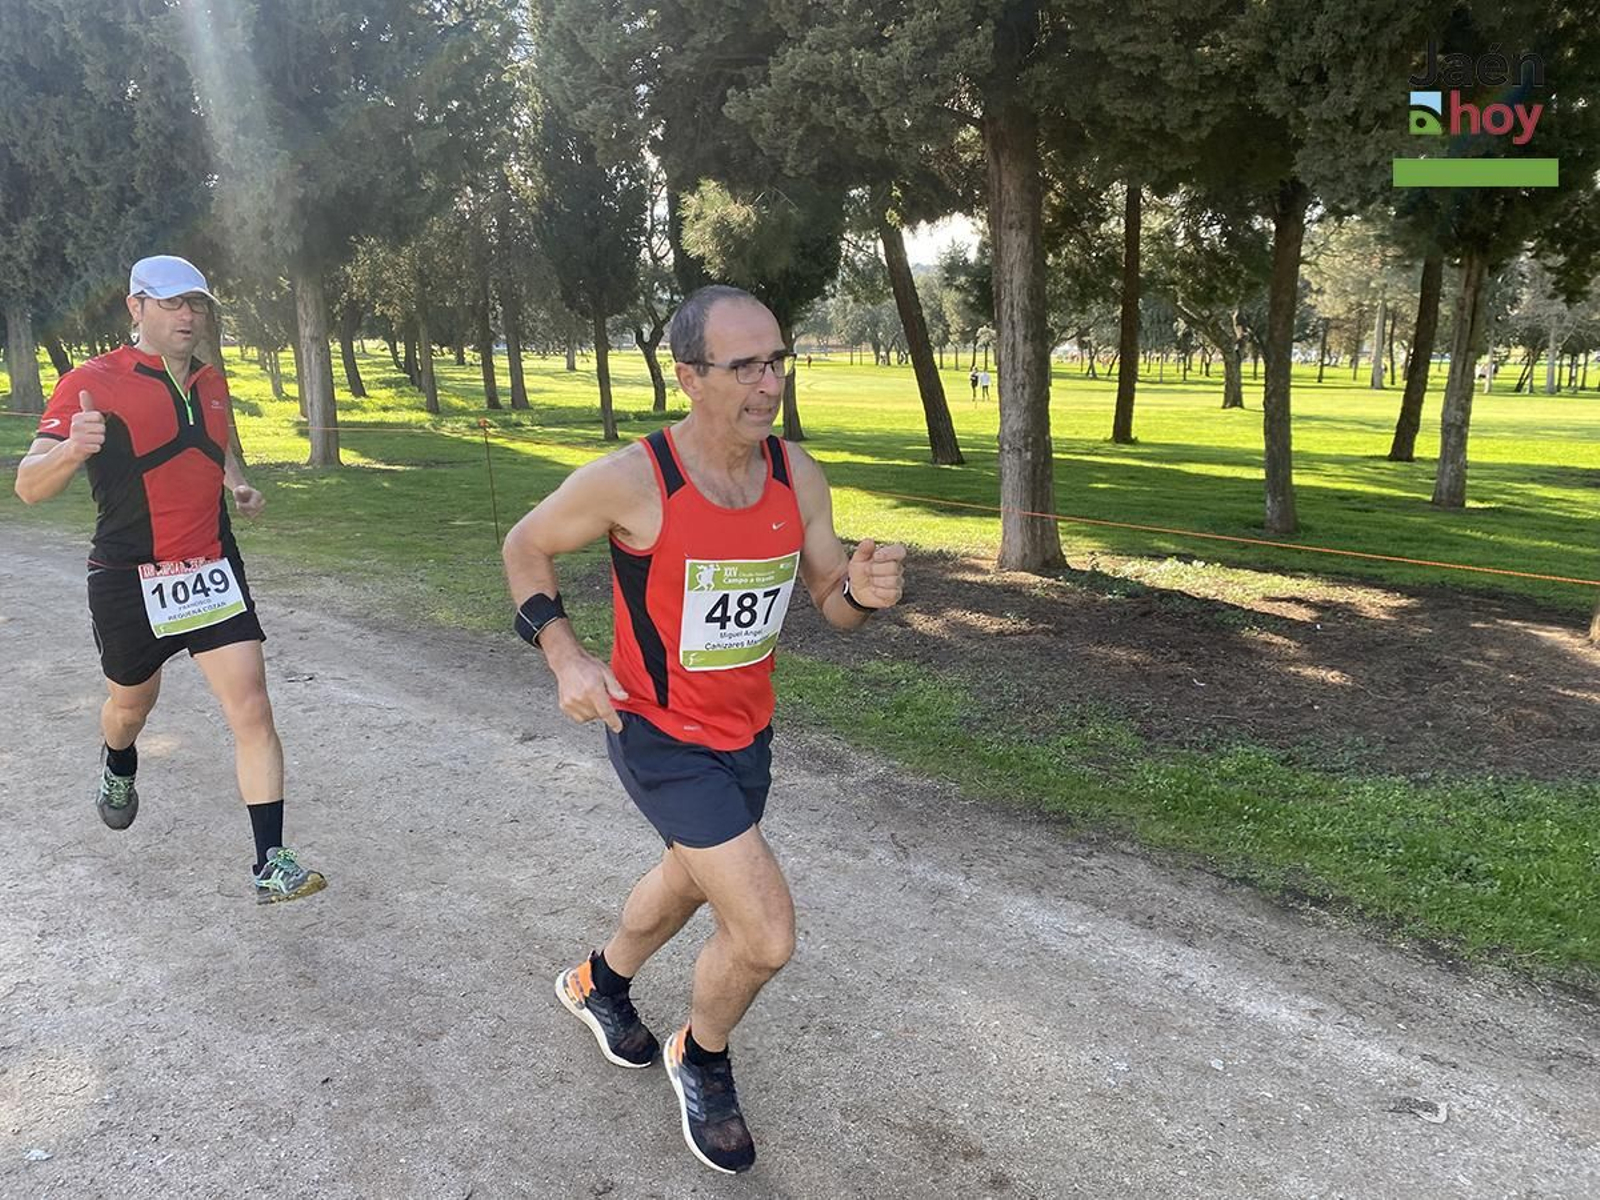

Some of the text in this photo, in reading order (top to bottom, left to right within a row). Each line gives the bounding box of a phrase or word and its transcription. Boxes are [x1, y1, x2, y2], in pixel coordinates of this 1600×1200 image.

[723, 566, 738, 577] XXV
[151, 568, 230, 609] 1049
[168, 608, 202, 621] REQUENA
[705, 587, 781, 630] 487
[720, 630, 743, 639] Miguel
